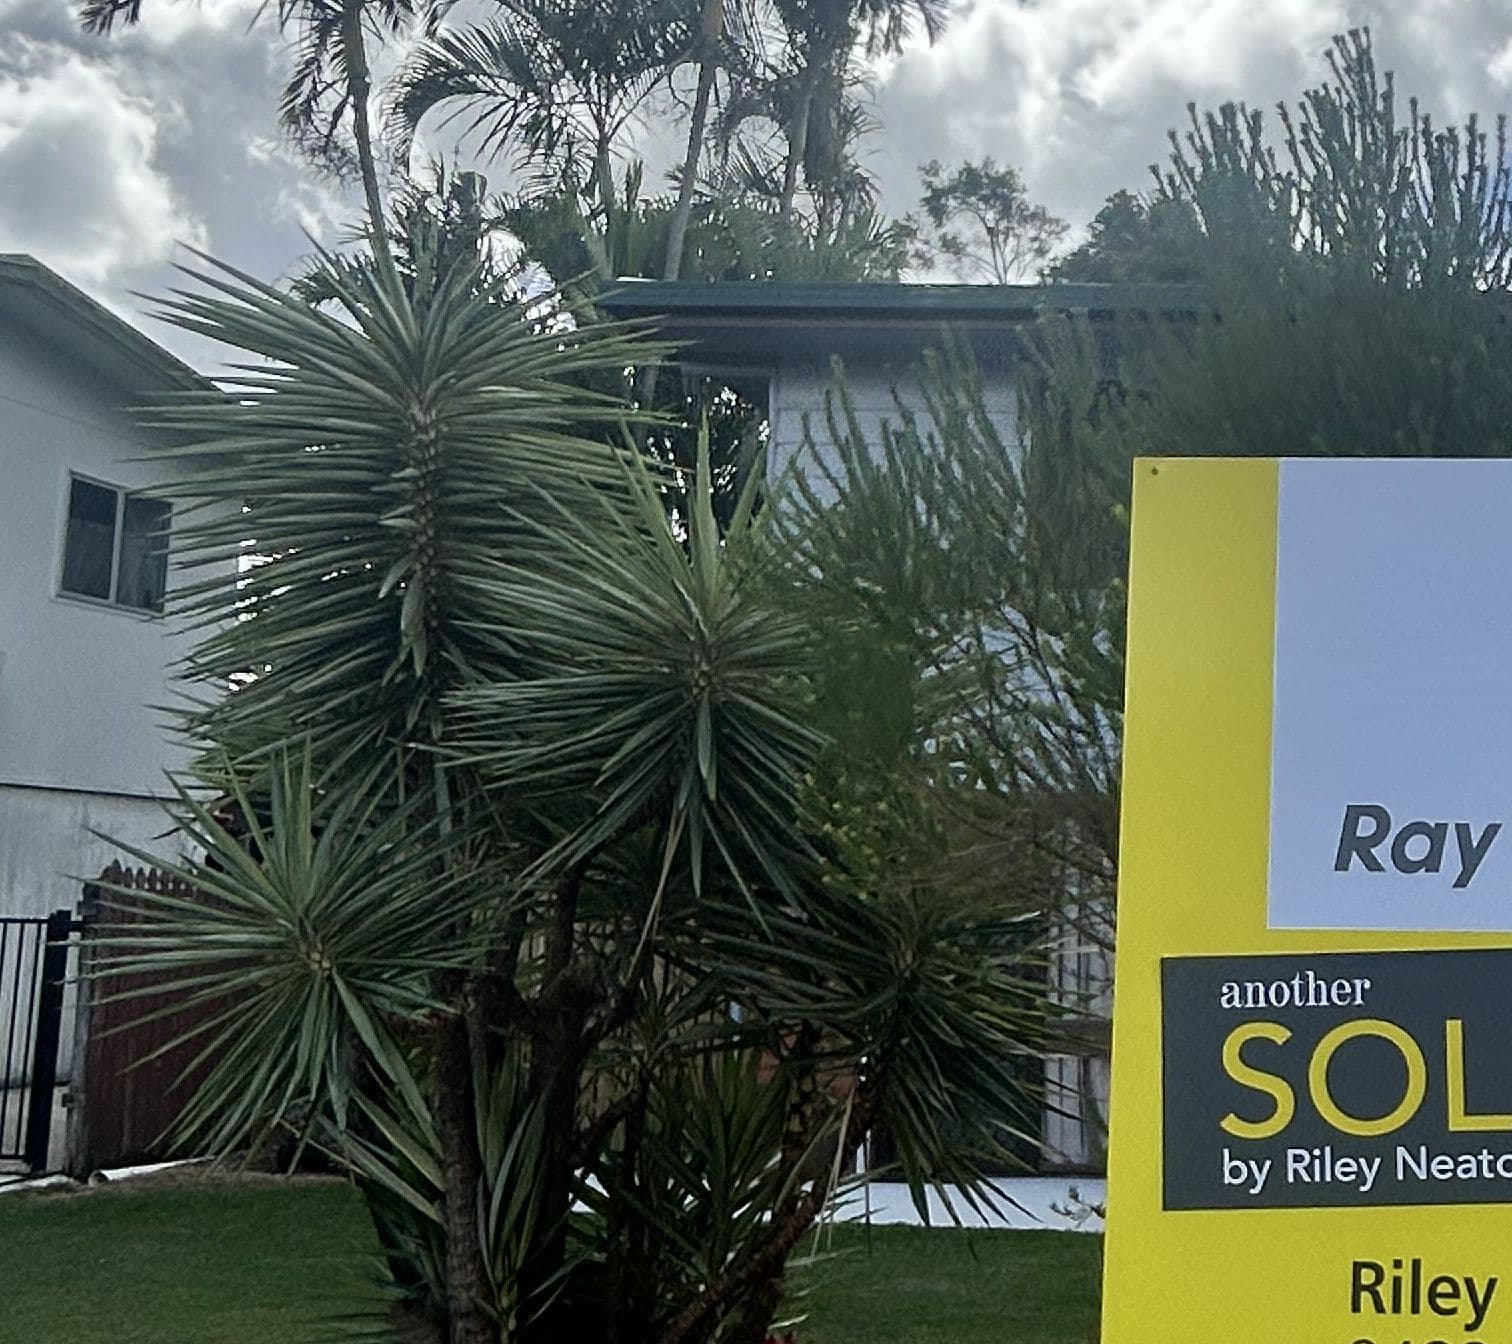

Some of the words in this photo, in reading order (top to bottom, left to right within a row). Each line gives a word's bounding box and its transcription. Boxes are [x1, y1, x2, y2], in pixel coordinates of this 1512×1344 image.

[1333, 804, 1503, 889] Ray
[1220, 970, 1371, 1009] another
[1222, 1148, 1272, 1194] by
[1286, 1145, 1382, 1192] Riley
[1350, 1258, 1498, 1333] Riley
